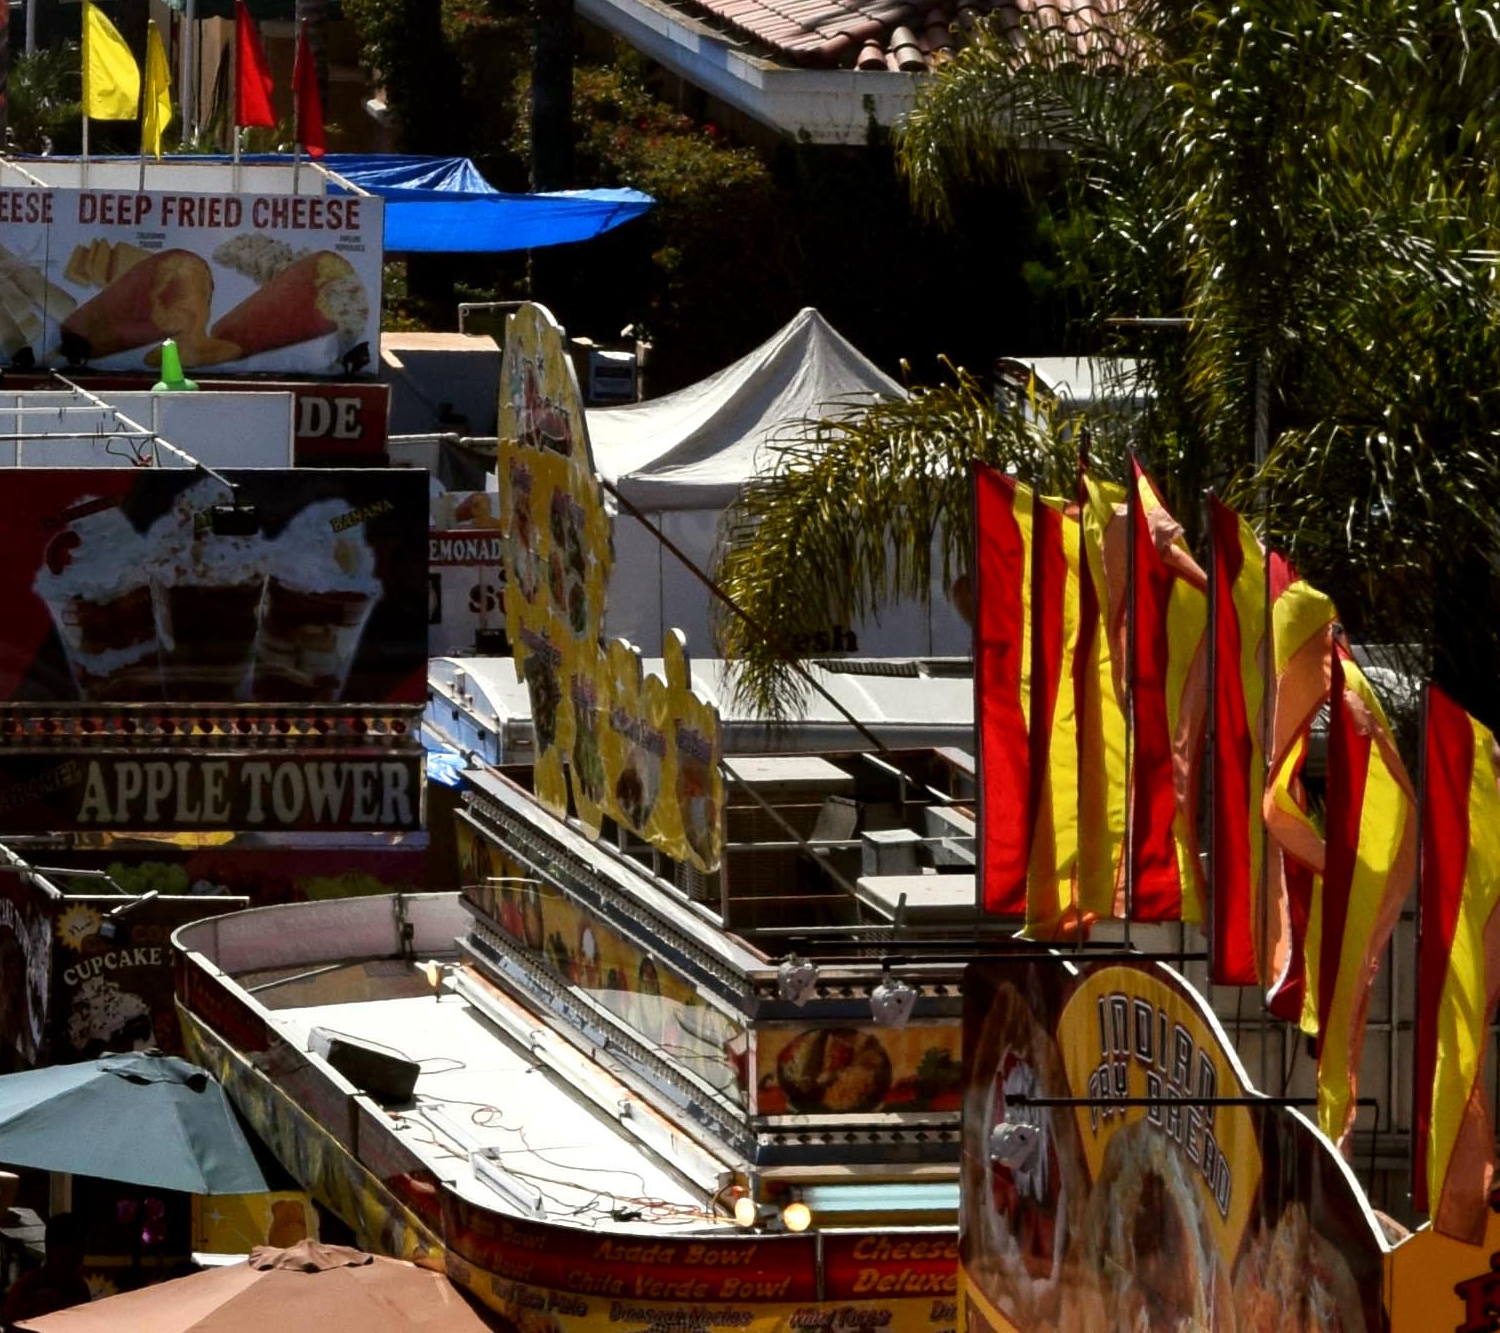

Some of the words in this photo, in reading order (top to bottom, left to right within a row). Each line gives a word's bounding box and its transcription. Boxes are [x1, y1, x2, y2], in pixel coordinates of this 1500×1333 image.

[78, 193, 152, 225] DEEP
[161, 195, 243, 228] FRIED
[252, 197, 361, 231] CHEESE
[428, 539, 500, 562] EMONAD
[77, 761, 233, 825] APPLE
[240, 762, 415, 825] TOWER
[62, 946, 162, 986] CUPCAKE
[593, 1238, 677, 1266] Asada
[685, 1241, 758, 1266] Bowl
[853, 1236, 959, 1261] Cheese
[633, 1276, 708, 1299] Verde
[719, 1275, 793, 1298] Bowl
[852, 1267, 958, 1294] Deluxe
